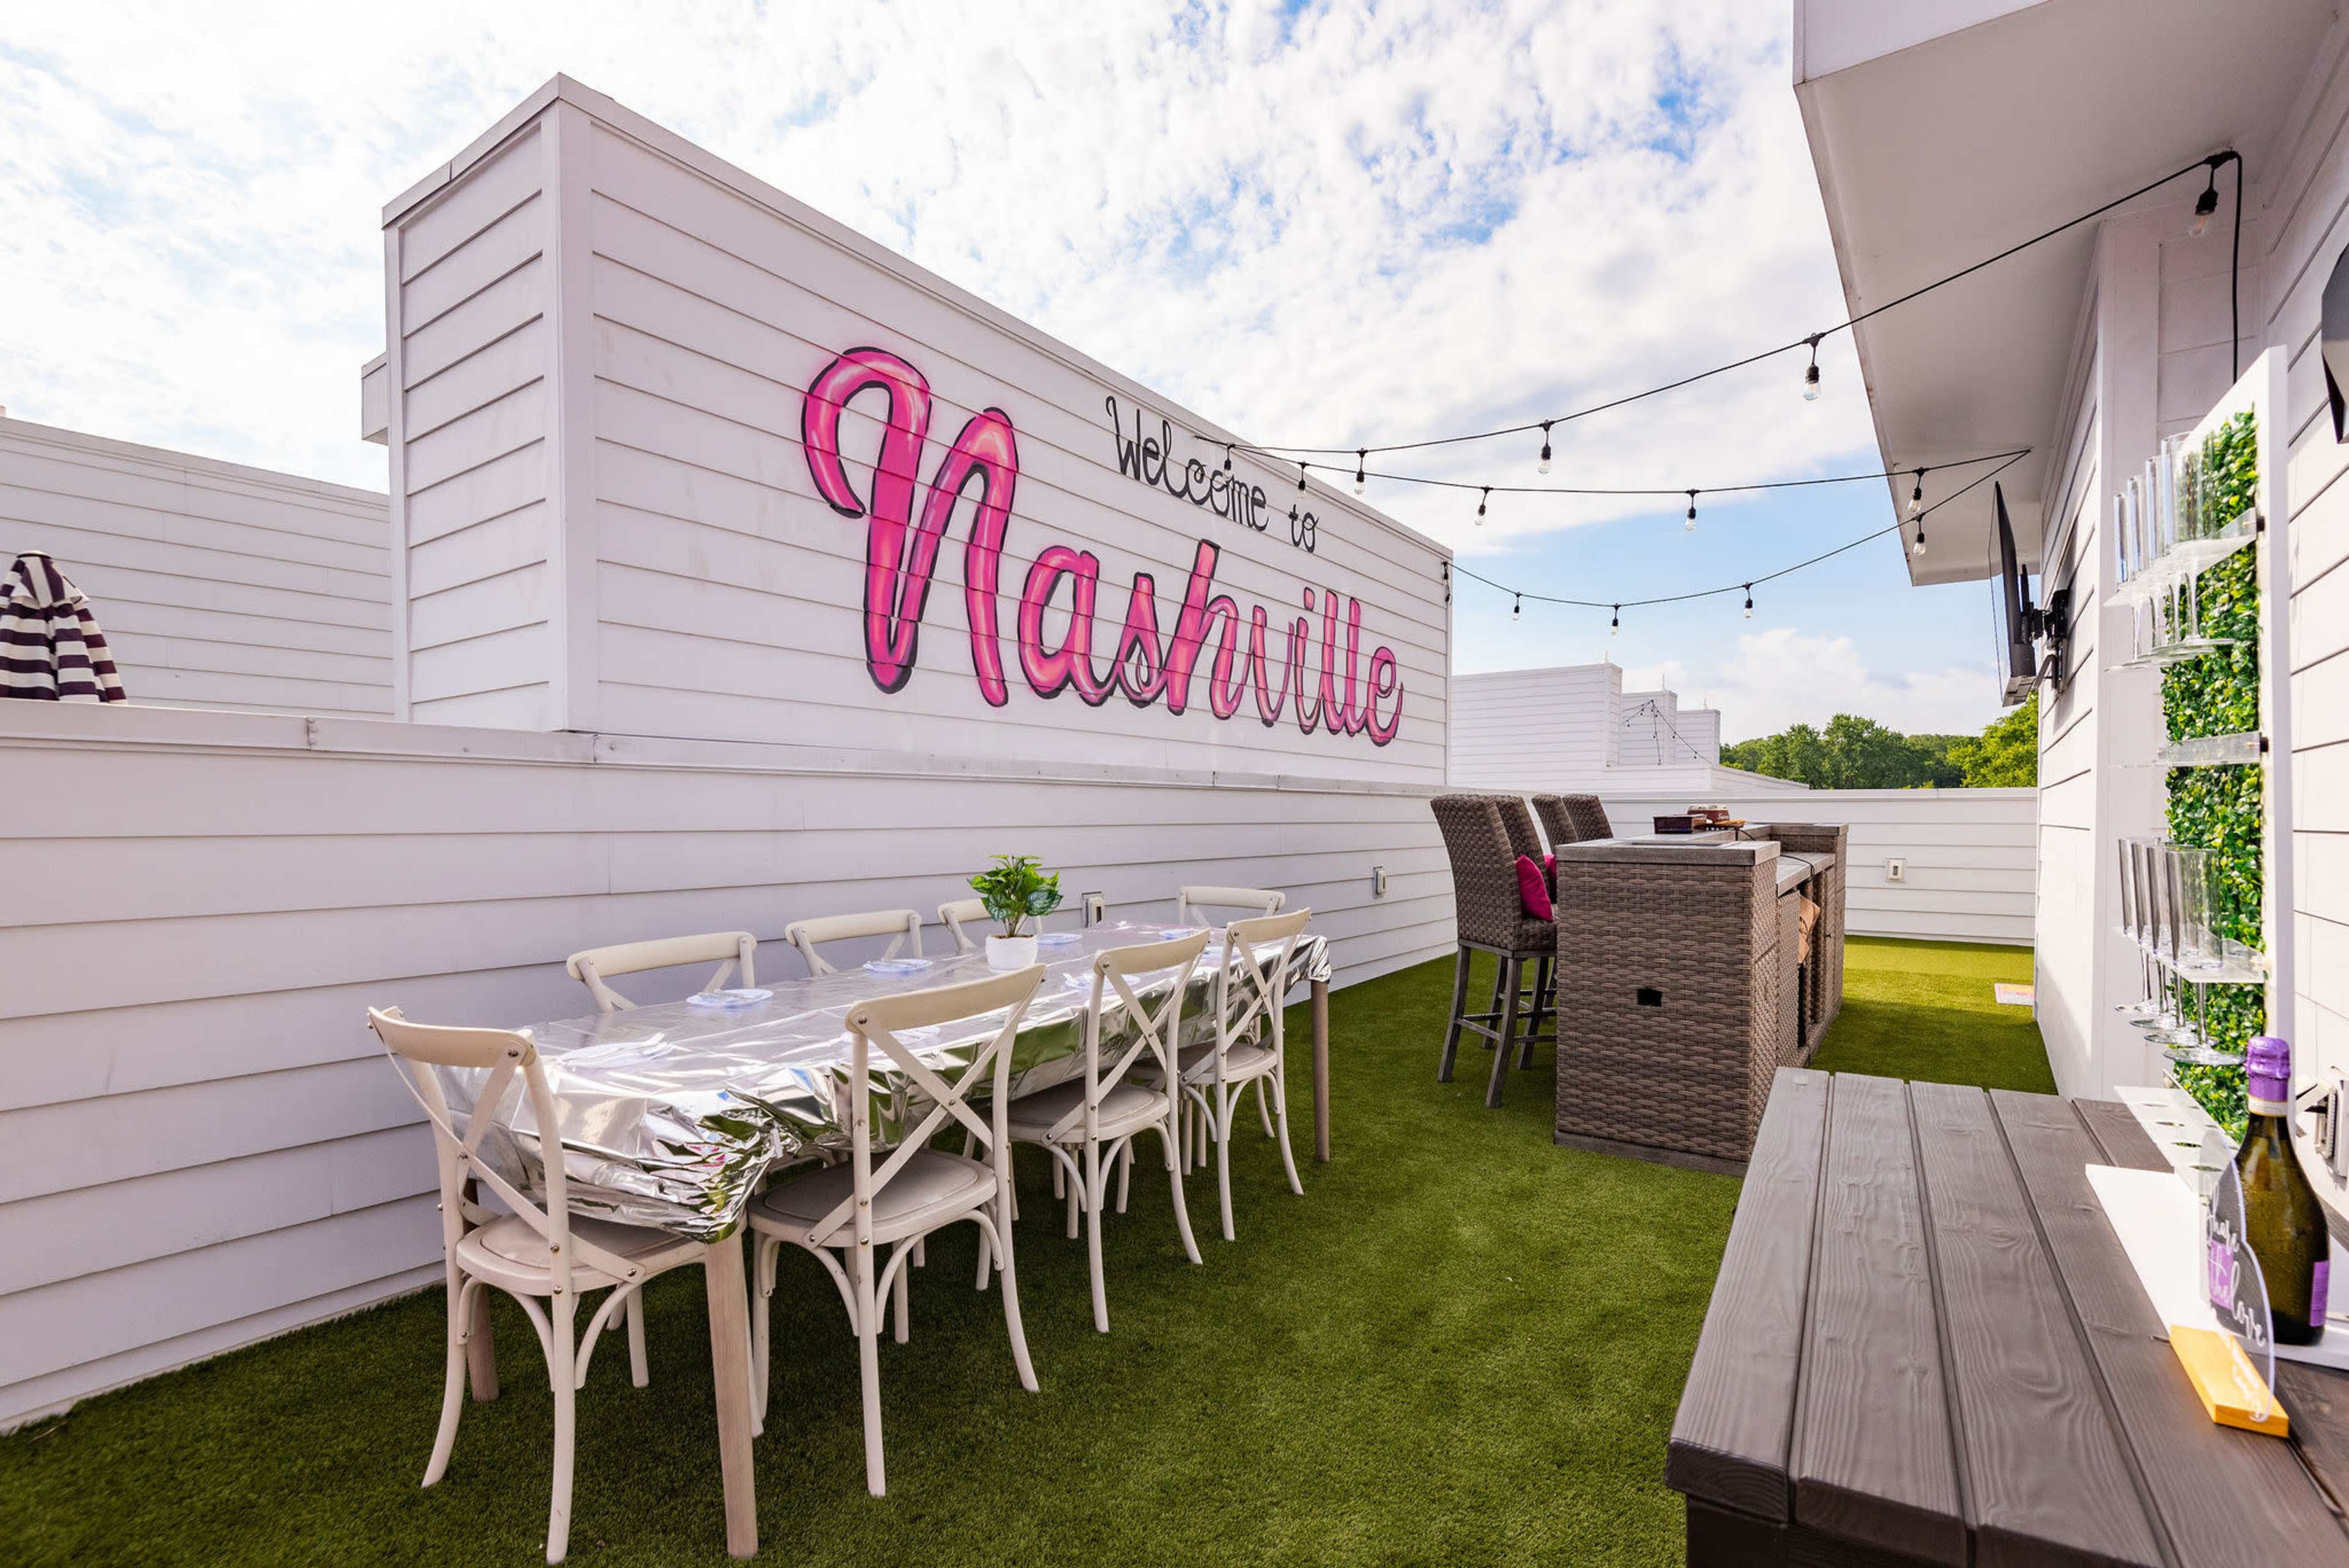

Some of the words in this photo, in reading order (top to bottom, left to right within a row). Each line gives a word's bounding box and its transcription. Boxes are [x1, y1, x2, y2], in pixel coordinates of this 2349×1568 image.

[801, 346, 1404, 748] Nashville
[1105, 395, 1269, 532] Welcome
[1288, 503, 1319, 554] to
